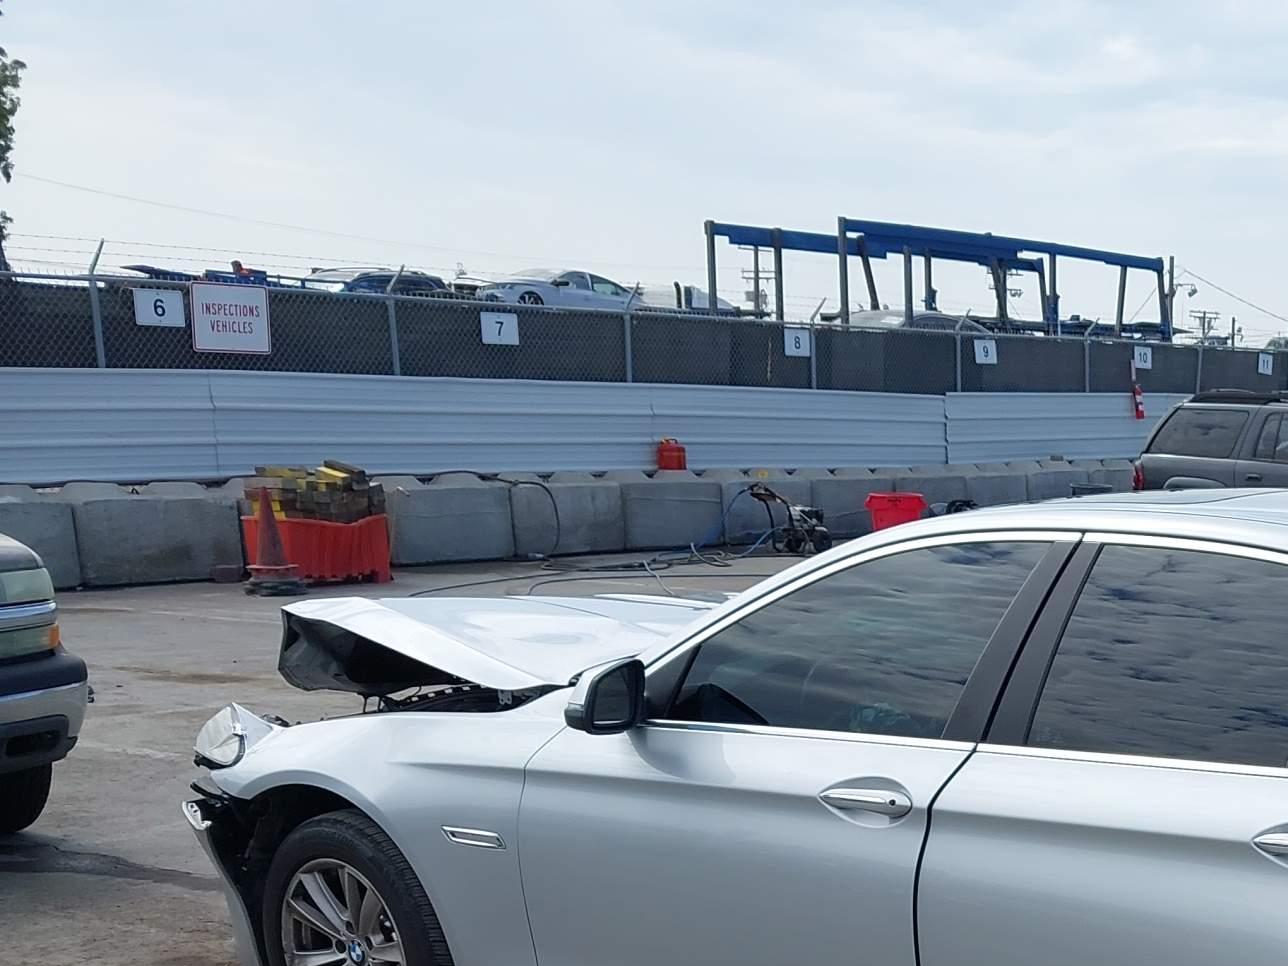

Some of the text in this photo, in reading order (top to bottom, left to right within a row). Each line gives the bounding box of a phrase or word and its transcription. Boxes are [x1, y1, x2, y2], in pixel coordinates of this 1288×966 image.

[153, 298, 166, 317] 6
[201, 302, 260, 318] INSPECTIONS
[209, 319, 253, 335] VEHICLES
[495, 320, 504, 337] 7
[794, 335, 801, 350] 8
[982, 345, 989, 358] 9
[1138, 352, 1148, 364] 10
[1262, 359, 1269, 369] 11
